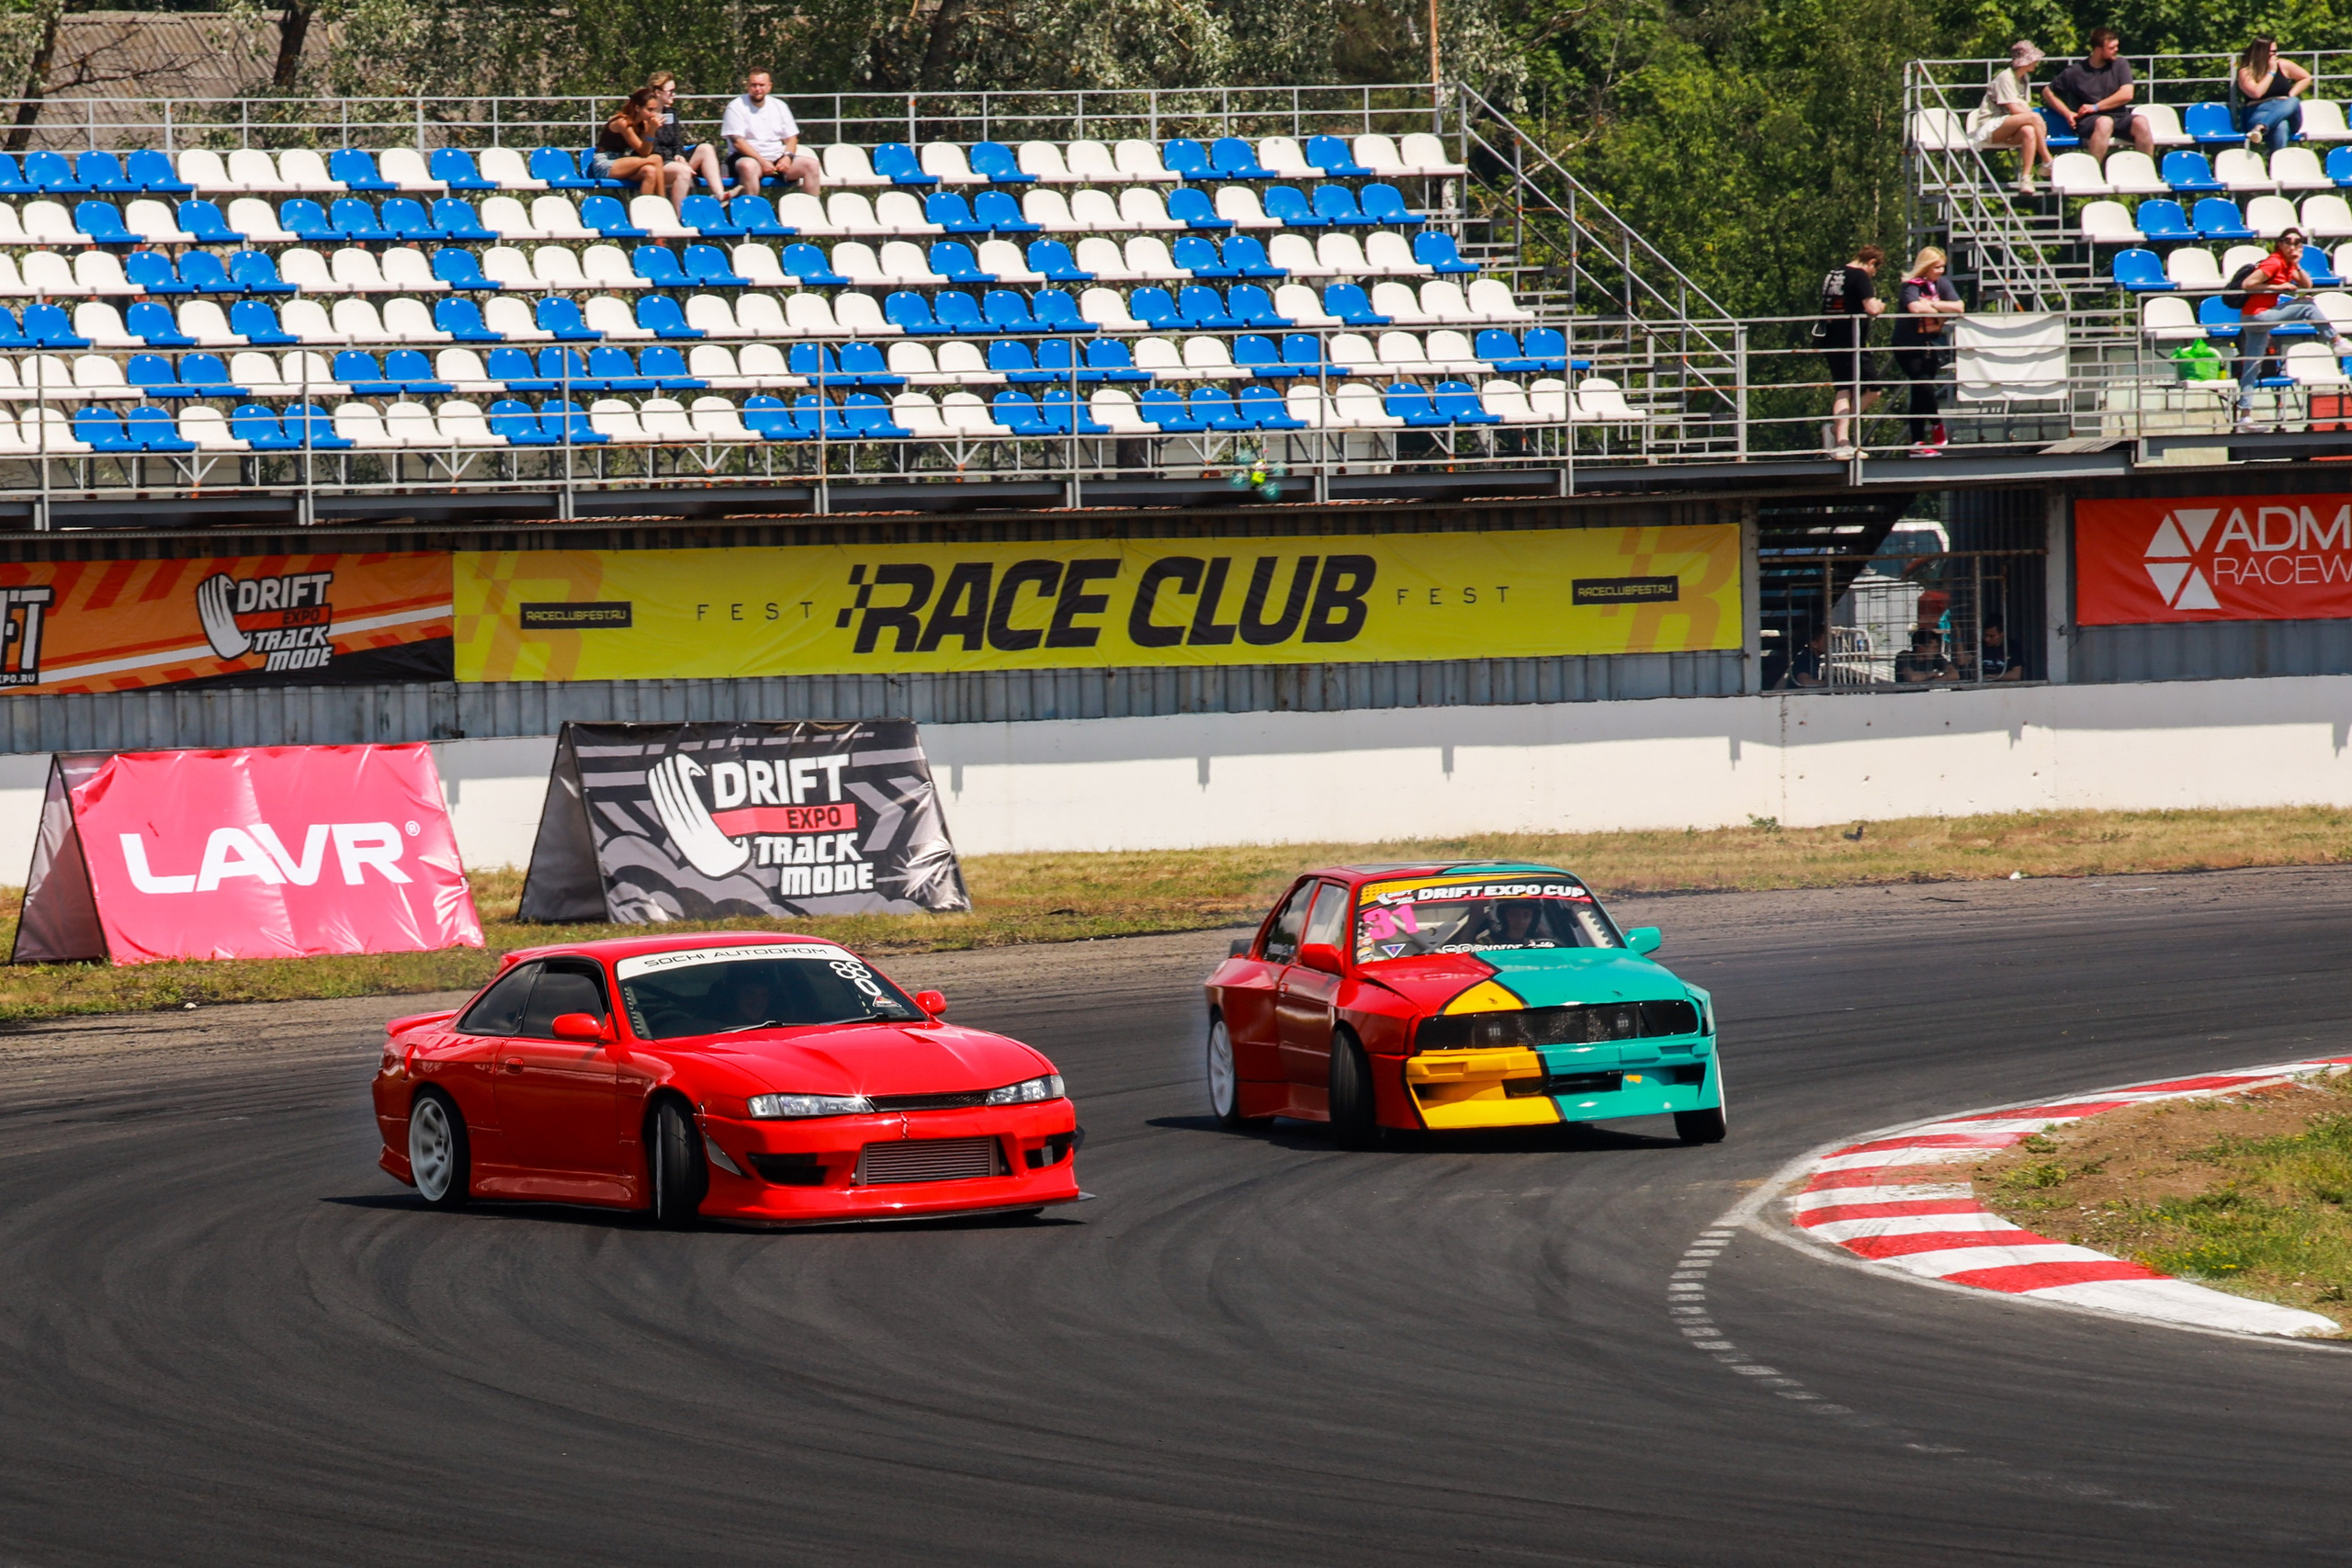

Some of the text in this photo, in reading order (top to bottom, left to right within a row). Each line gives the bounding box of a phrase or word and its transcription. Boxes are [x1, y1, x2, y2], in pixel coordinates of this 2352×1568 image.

[2214, 504, 2352, 553] ADM
[237, 573, 332, 613] DRIFT
[836, 554, 1377, 653] RACE CLUB
[1396, 585, 1510, 606] FEST
[283, 609, 320, 626] EXPO
[696, 602, 814, 622] FEST
[254, 626, 329, 652] TRACK
[266, 646, 334, 672] MODE
[711, 753, 850, 809] DRIFT
[786, 807, 842, 829] EXPO
[753, 832, 863, 865] TRACK
[781, 862, 874, 896] MODE
[1417, 884, 1586, 901] DRIFT EXPO CUP
[1363, 904, 1420, 941] 31
[644, 947, 828, 967] SOCHI AUTODROM
